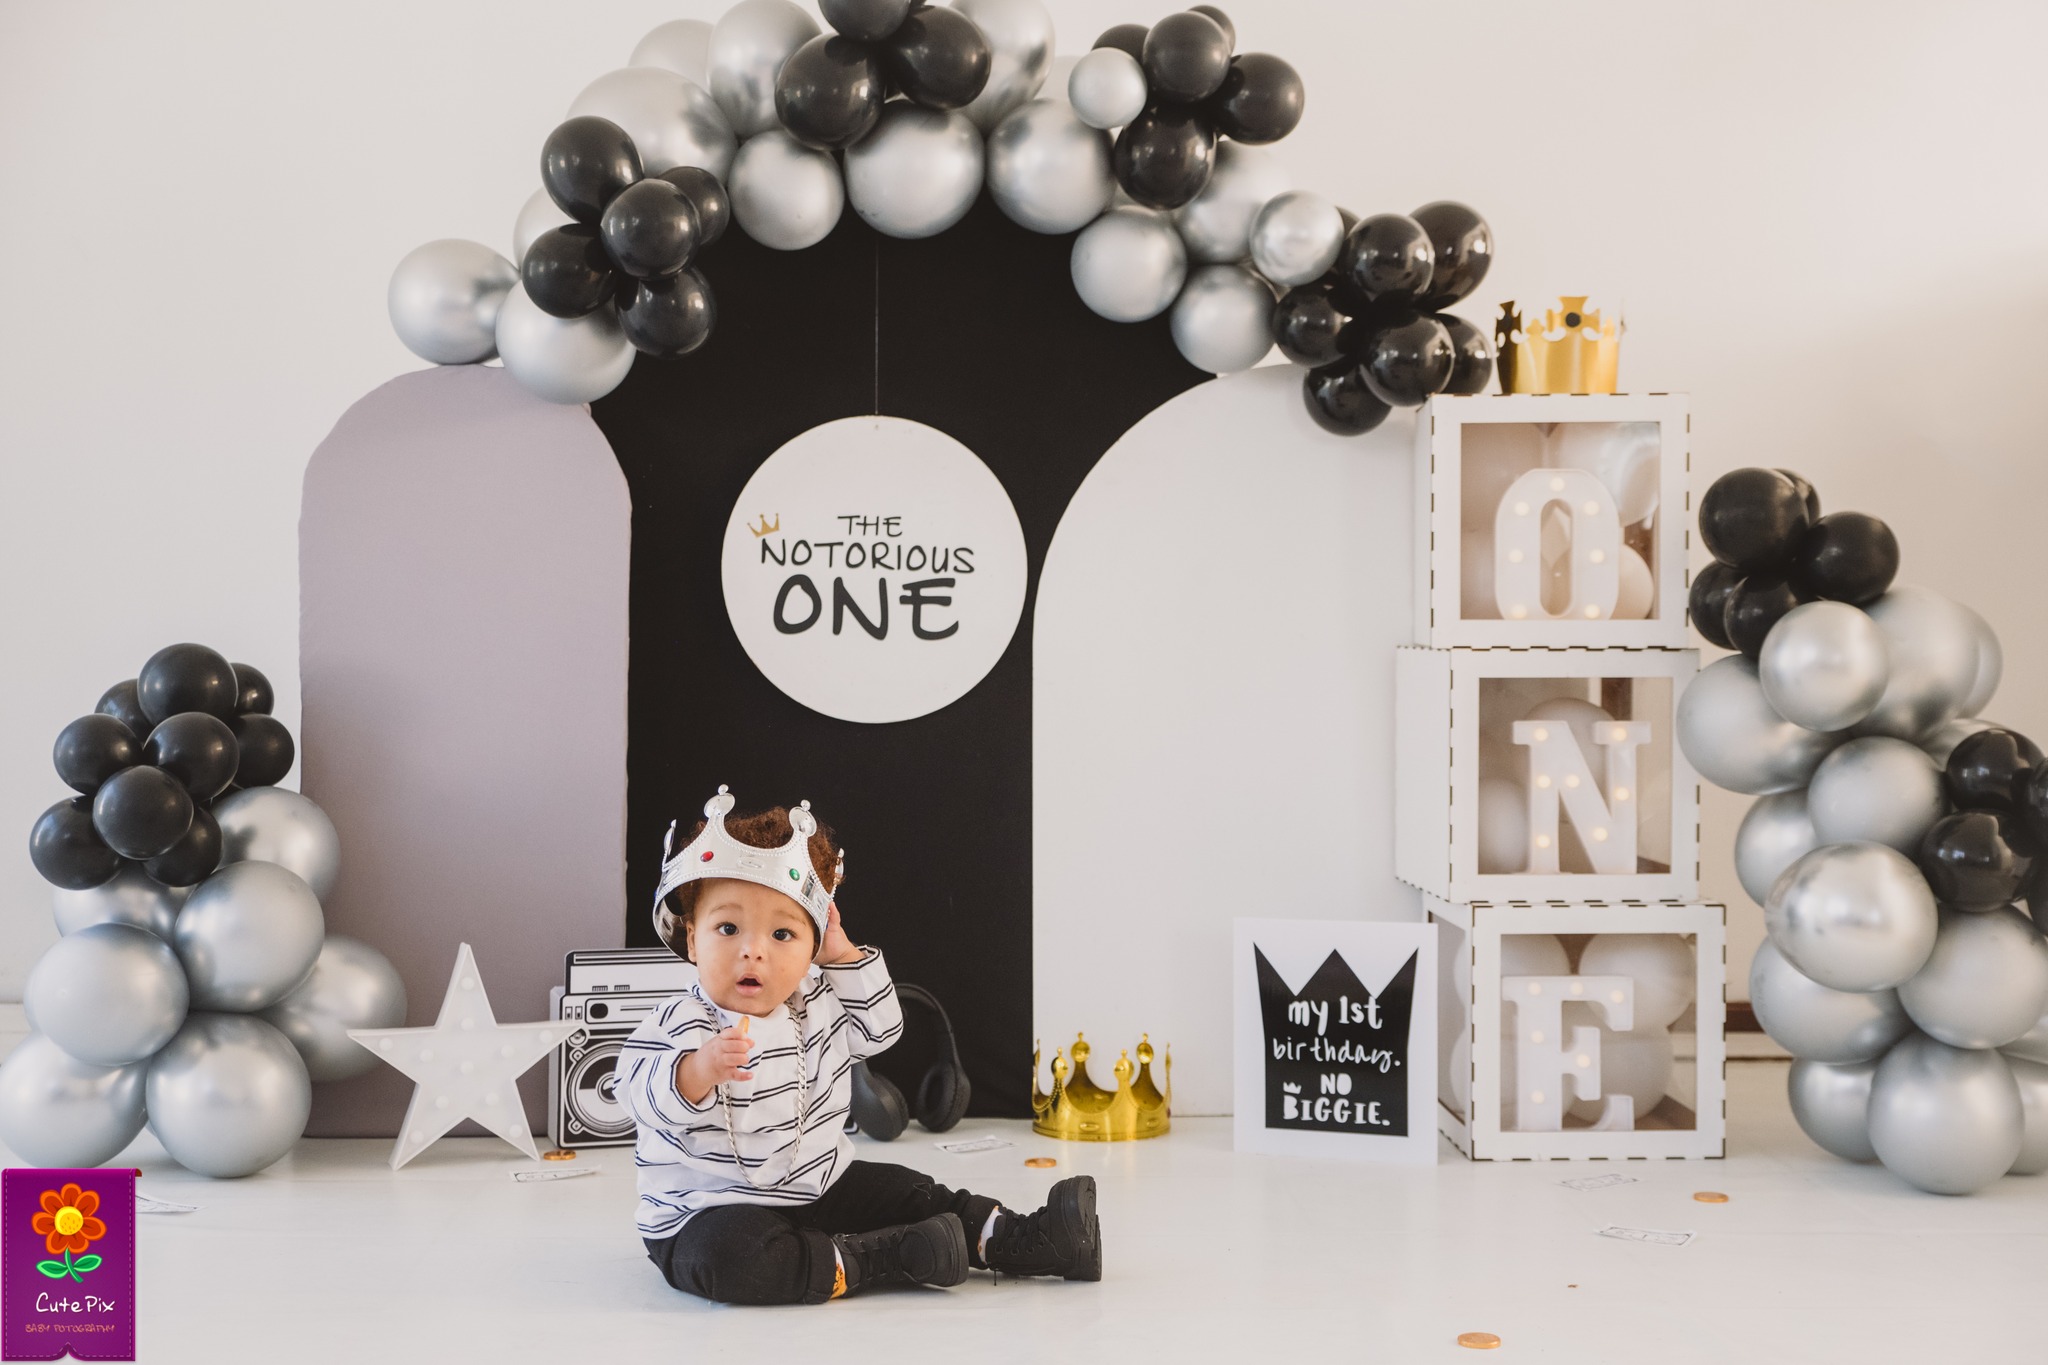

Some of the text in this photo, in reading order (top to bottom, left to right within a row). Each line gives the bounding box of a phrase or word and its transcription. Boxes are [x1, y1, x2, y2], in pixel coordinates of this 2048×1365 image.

[838, 515, 903, 537] THE
[761, 538, 975, 574] NOTORIOUS
[773, 574, 959, 640] ONE
[1288, 995, 1383, 1036] my 1st
[1272, 1036, 1401, 1073] birthday.
[1320, 1073, 1352, 1095] NO
[1282, 1094, 1391, 1126] BIGGIE.
